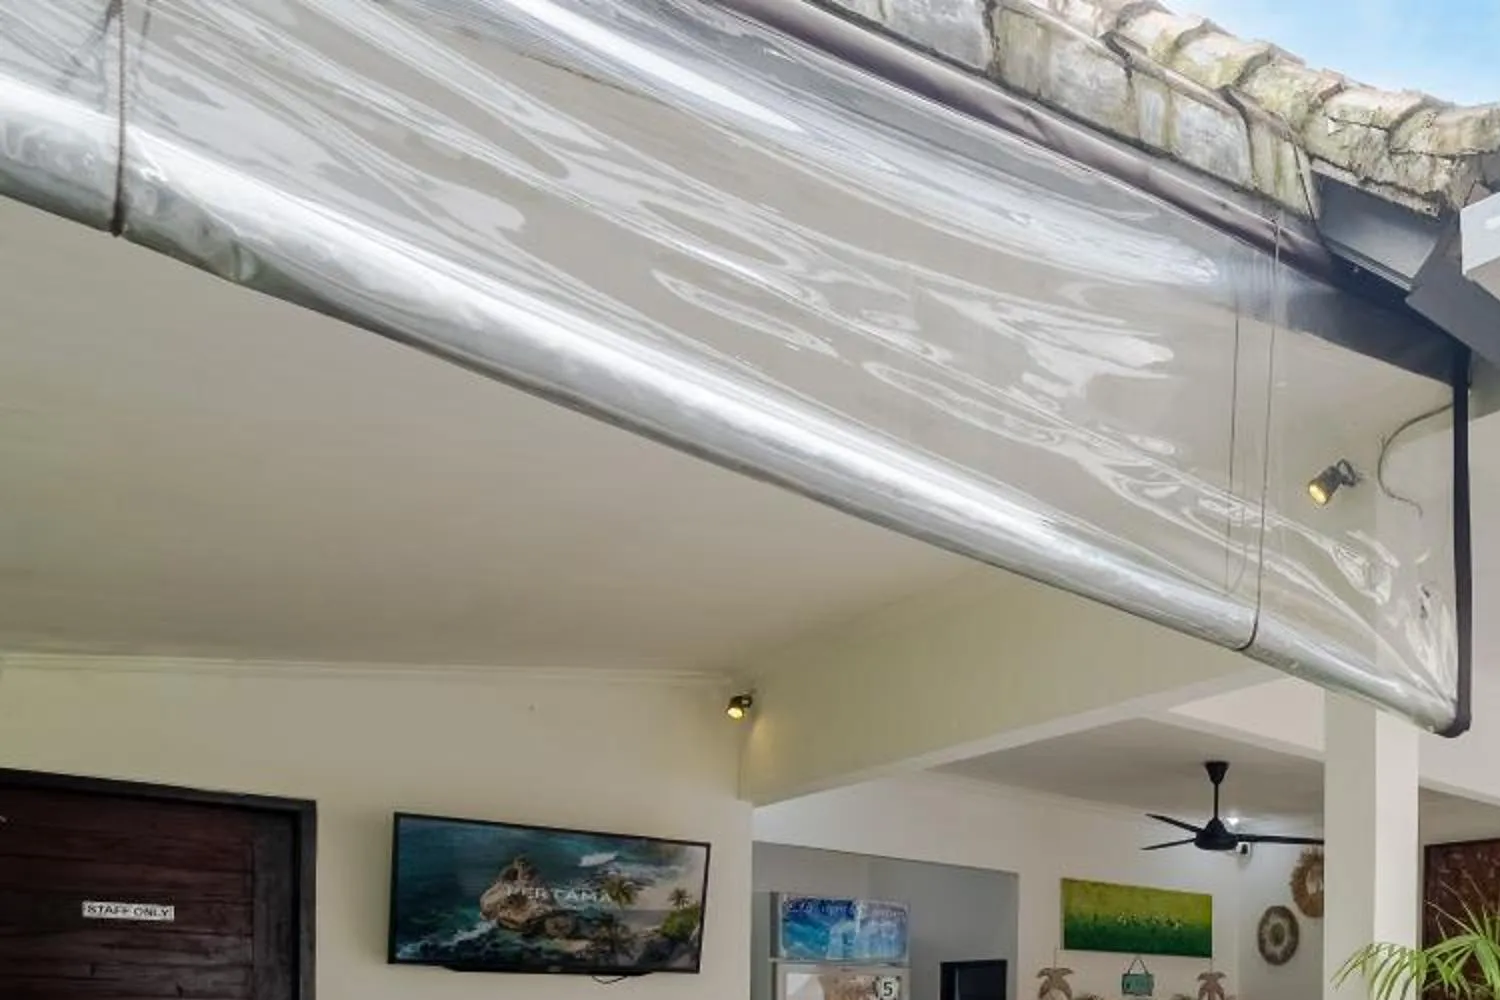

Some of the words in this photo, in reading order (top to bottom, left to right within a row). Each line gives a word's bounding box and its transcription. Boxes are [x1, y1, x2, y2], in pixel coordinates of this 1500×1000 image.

[87, 905, 129, 915] STAFF
[133, 907, 169, 917] ONLY
[882, 981, 894, 997] 5
